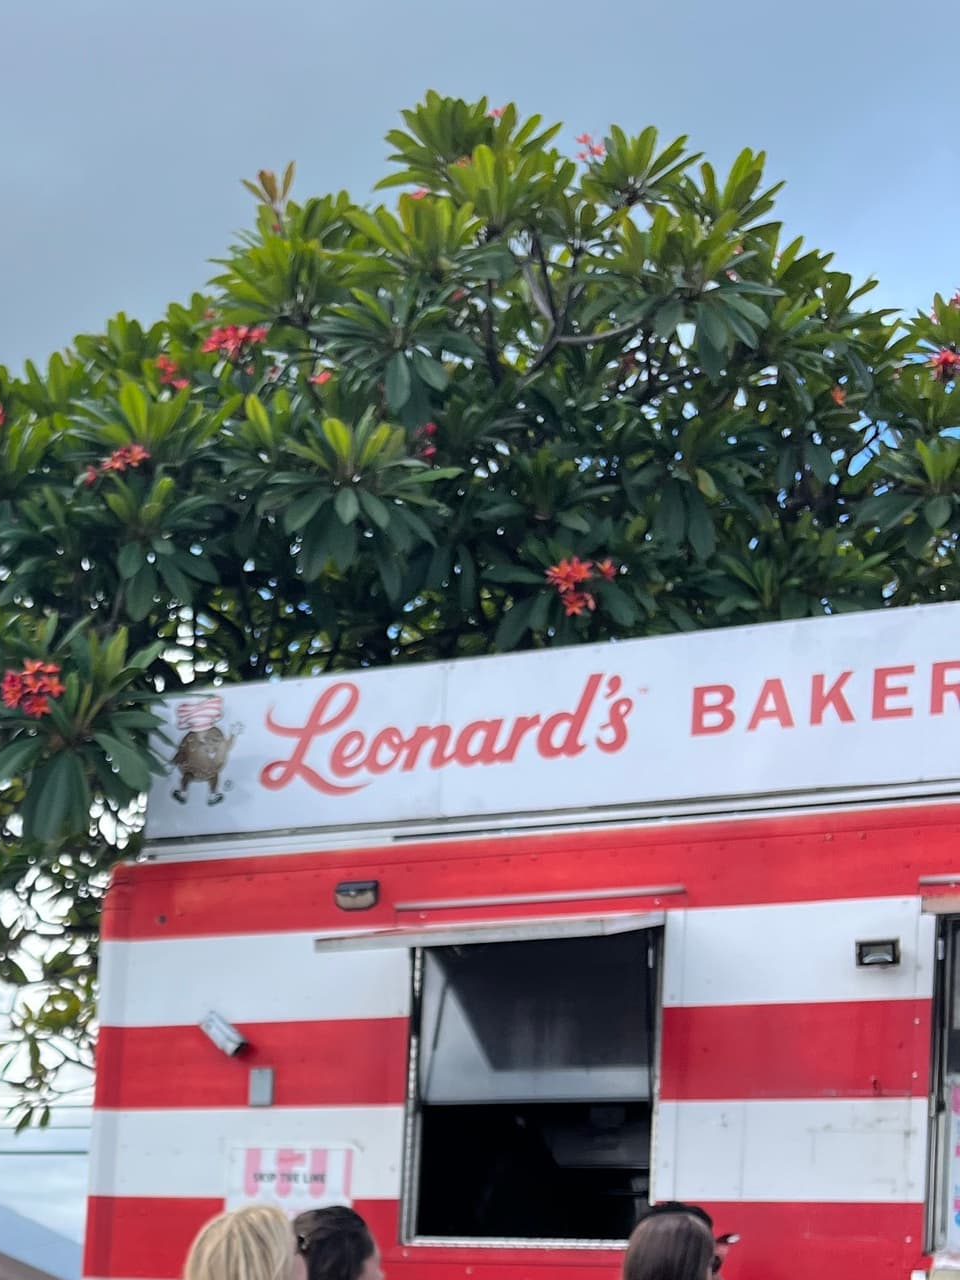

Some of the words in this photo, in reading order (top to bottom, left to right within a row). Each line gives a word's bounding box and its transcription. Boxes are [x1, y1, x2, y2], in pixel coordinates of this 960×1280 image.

[259, 672, 635, 797] Leonard's
[690, 660, 960, 737] BAKER
[253, 1173, 276, 1184] SKIP
[280, 1173, 299, 1184] THE
[303, 1173, 326, 1184] LINE
